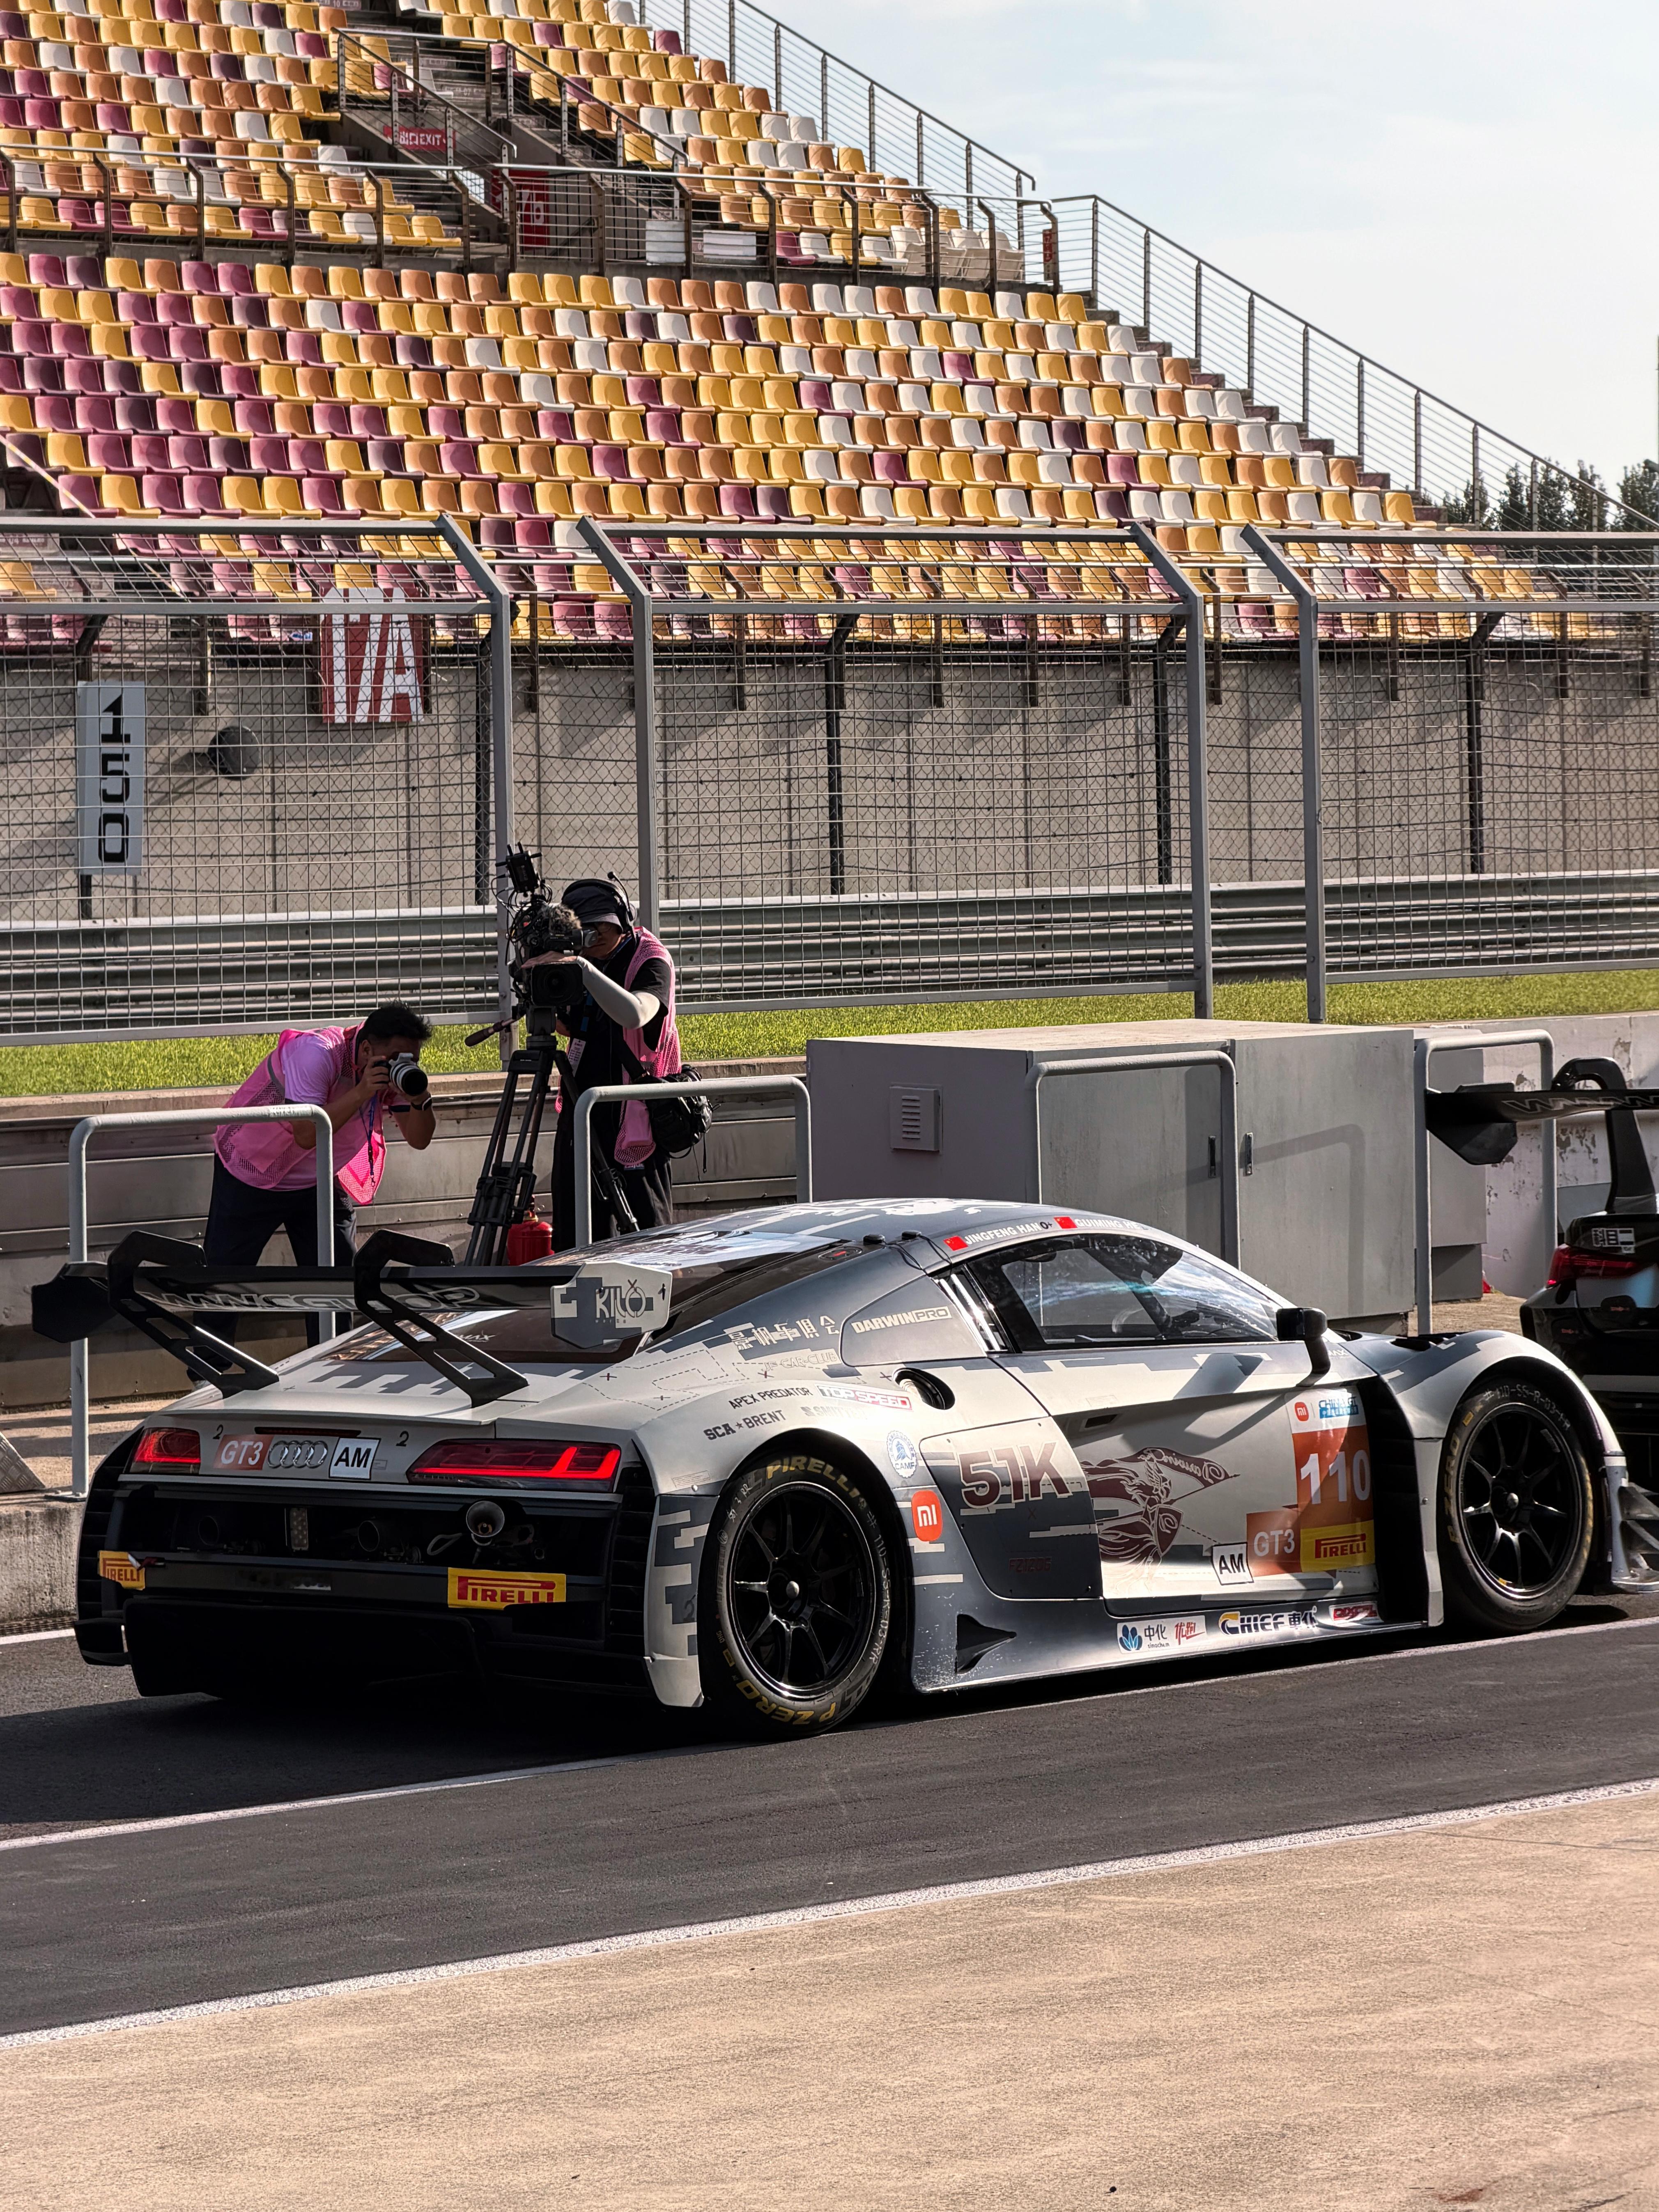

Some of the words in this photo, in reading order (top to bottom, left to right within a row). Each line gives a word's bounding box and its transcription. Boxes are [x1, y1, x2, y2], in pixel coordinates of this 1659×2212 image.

[400, 131, 418, 146] 出口
[420, 134, 441, 146] EXIT
[98, 694, 131, 863] 150
[965, 1227, 1018, 1245] JINGFENG
[1019, 1222, 1041, 1233] HAN
[1075, 1218, 1122, 1229] GUIMING
[728, 1394, 760, 1409] APEX
[758, 1387, 813, 1401] PREDATOR
[819, 1386, 855, 1400] TOP
[703, 1423, 736, 1440] SCA
[742, 1410, 786, 1429] BRENT
[396, 1431, 409, 1447] 2
[221, 1440, 263, 1465] GT3
[334, 1447, 371, 1468] AM
[766, 1456, 861, 1498] PIRELLI
[895, 1462, 915, 1470] CAMF
[957, 1441, 1073, 1508] 51K
[1301, 1449, 1371, 1505] 110
[1254, 1529, 1295, 1557] GT3
[1315, 1533, 1367, 1559] PIRELLI
[103, 1558, 140, 1582] PIRELLI
[1219, 1553, 1246, 1575] AM
[457, 1576, 556, 1603] PIRELLI
[1144, 1624, 1167, 1641] 中化
[1219, 1611, 1285, 1635] CHIEF
[736, 1679, 815, 1725] ZERO
